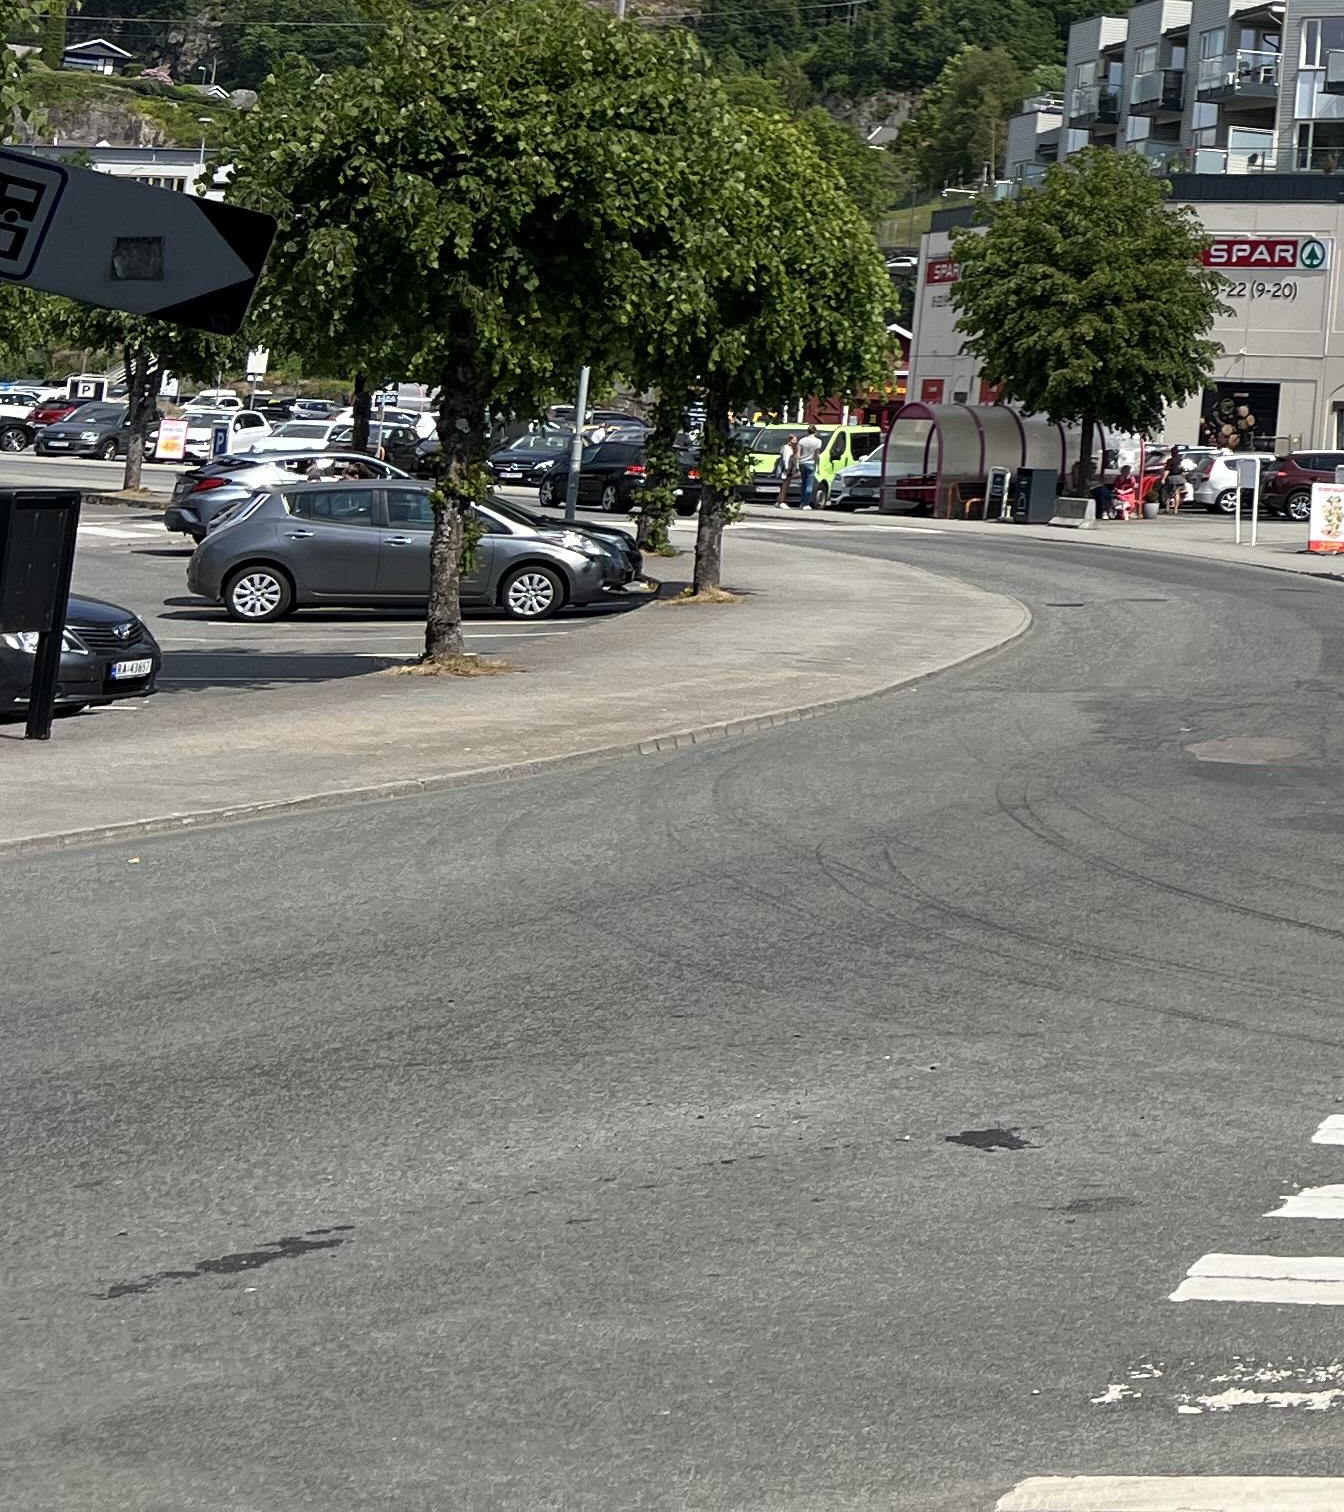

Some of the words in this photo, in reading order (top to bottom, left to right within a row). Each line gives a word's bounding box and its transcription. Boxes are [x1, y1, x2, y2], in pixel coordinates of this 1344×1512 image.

[1209, 244, 1294, 263] SPAR
[933, 263, 960, 280] SPAR
[1251, 280, 1298, 301] (9-20)
[82, 385, 90, 395] P
